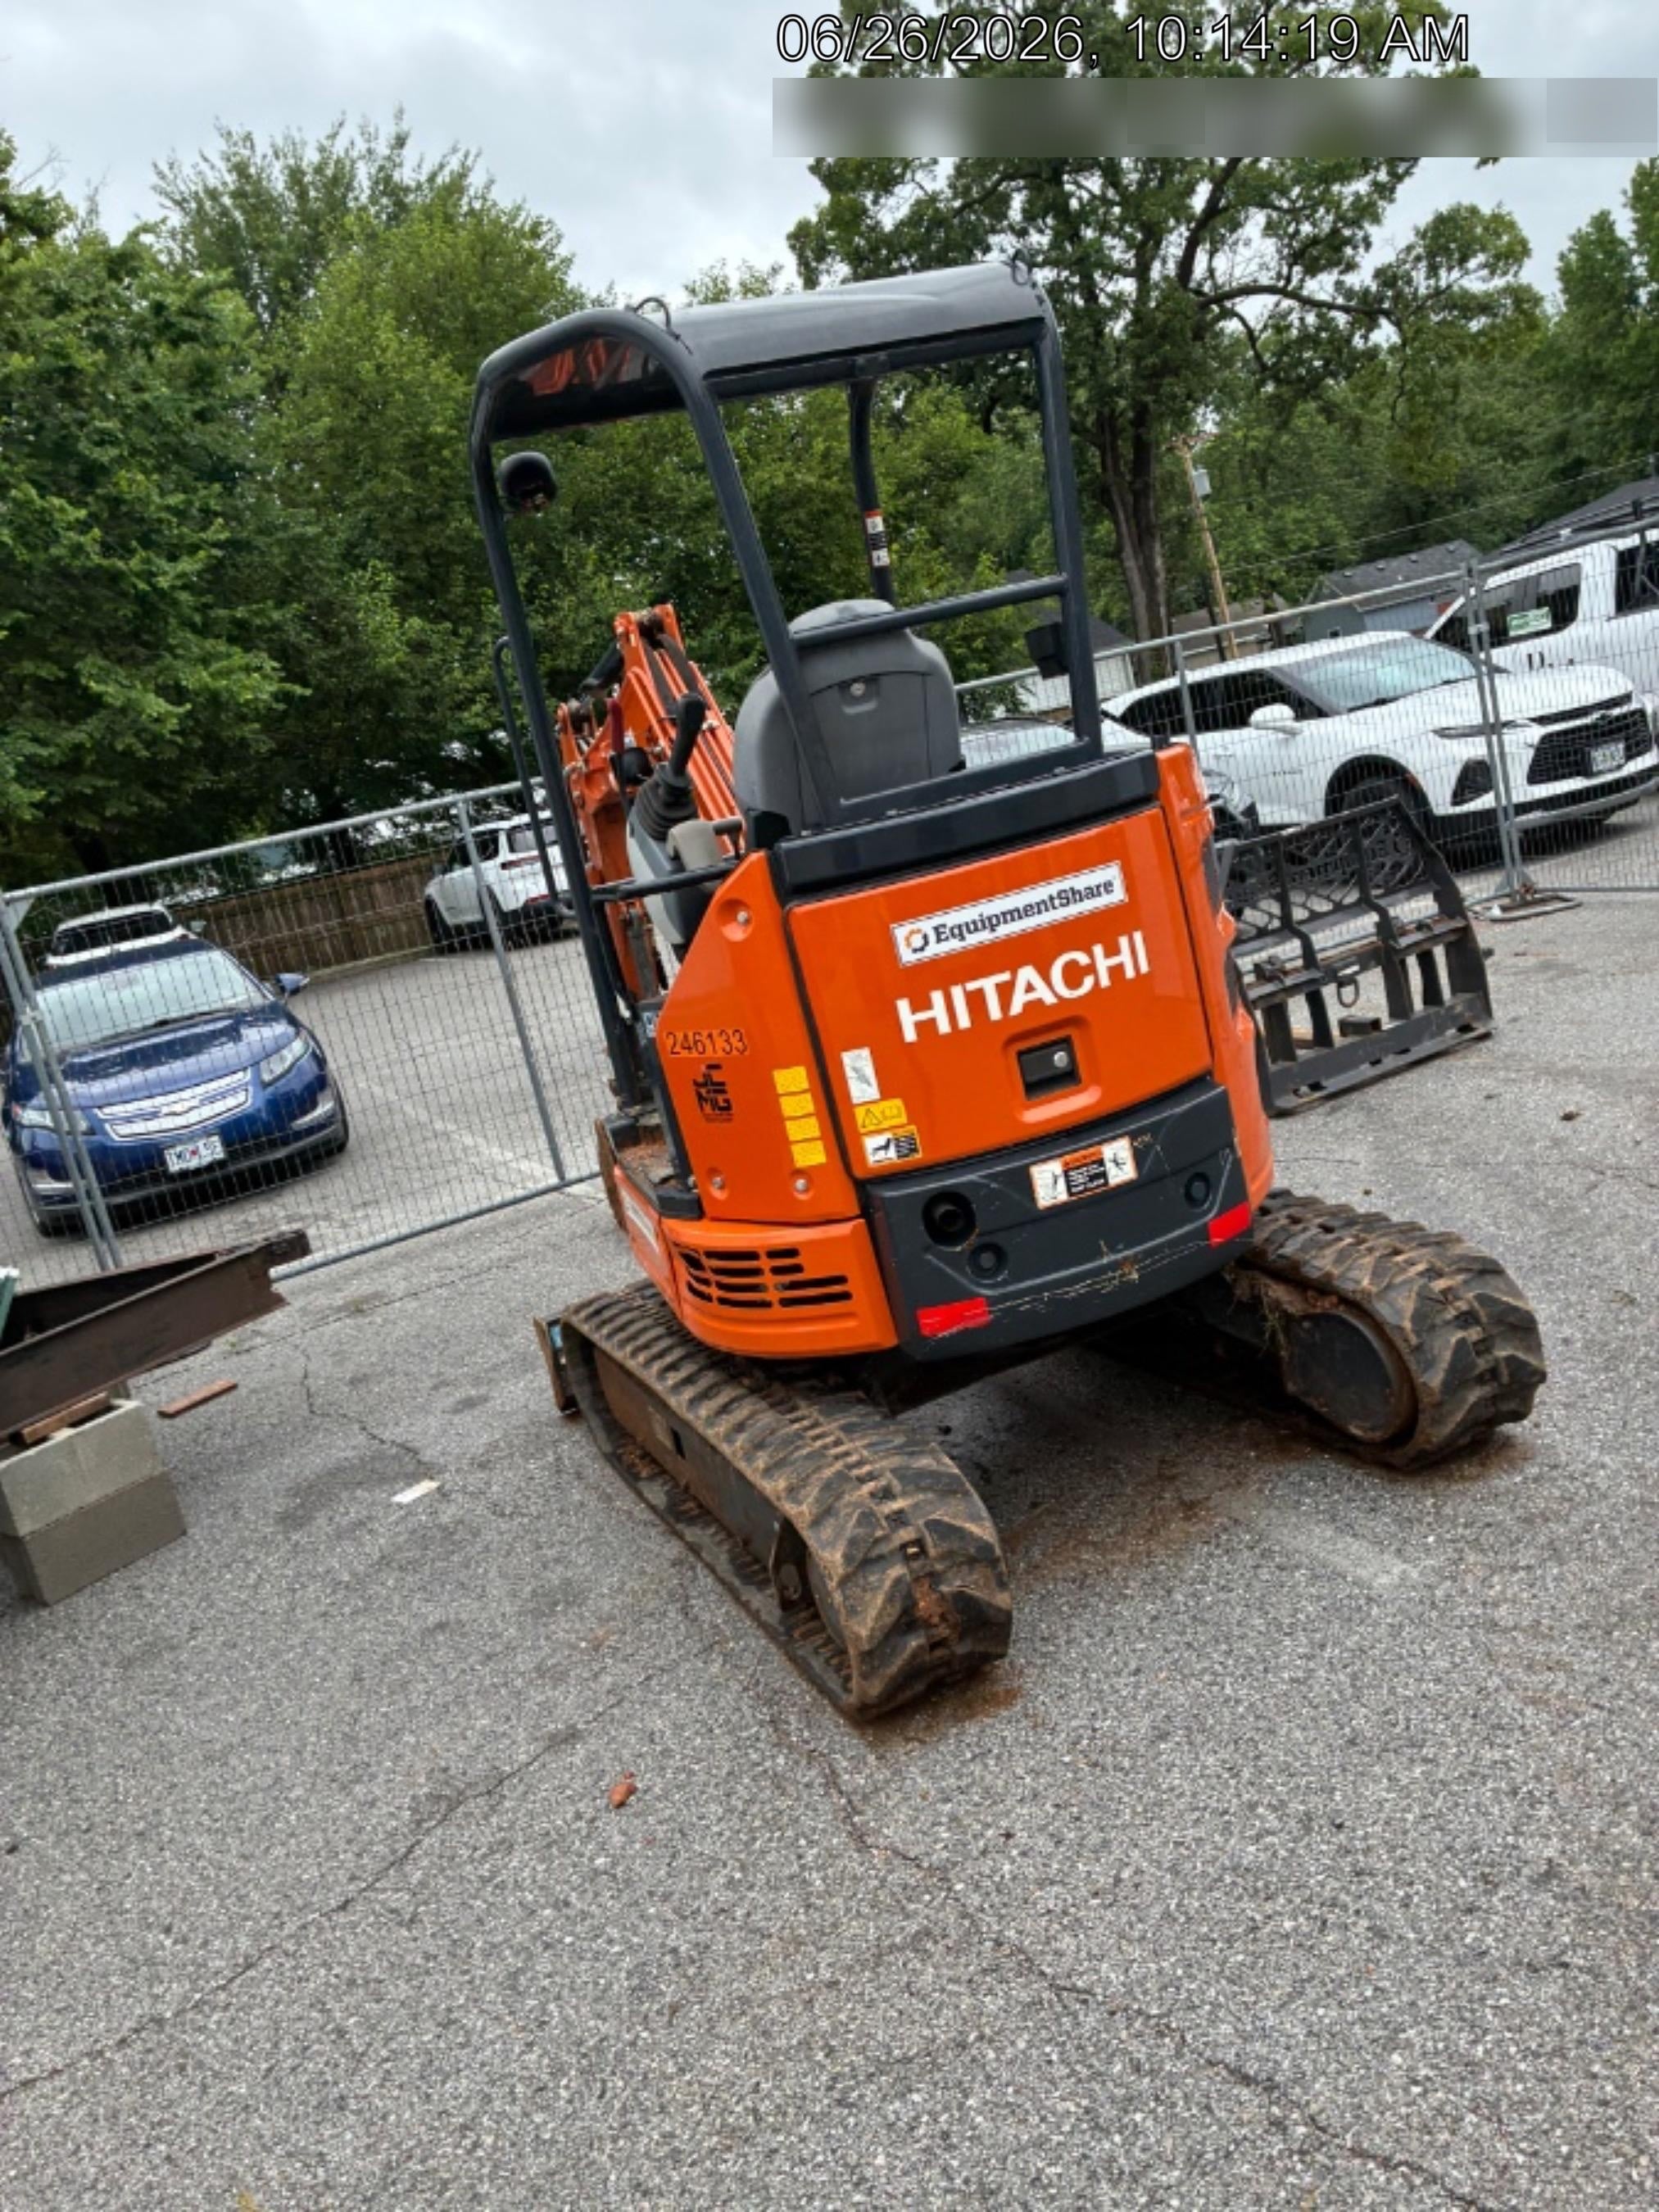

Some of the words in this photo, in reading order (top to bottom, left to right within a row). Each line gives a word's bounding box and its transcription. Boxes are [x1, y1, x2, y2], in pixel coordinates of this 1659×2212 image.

[932, 878, 1114, 944] EquipmentShare
[895, 931, 1149, 1043] HITACHI
[666, 1030, 747, 1054] 246133
